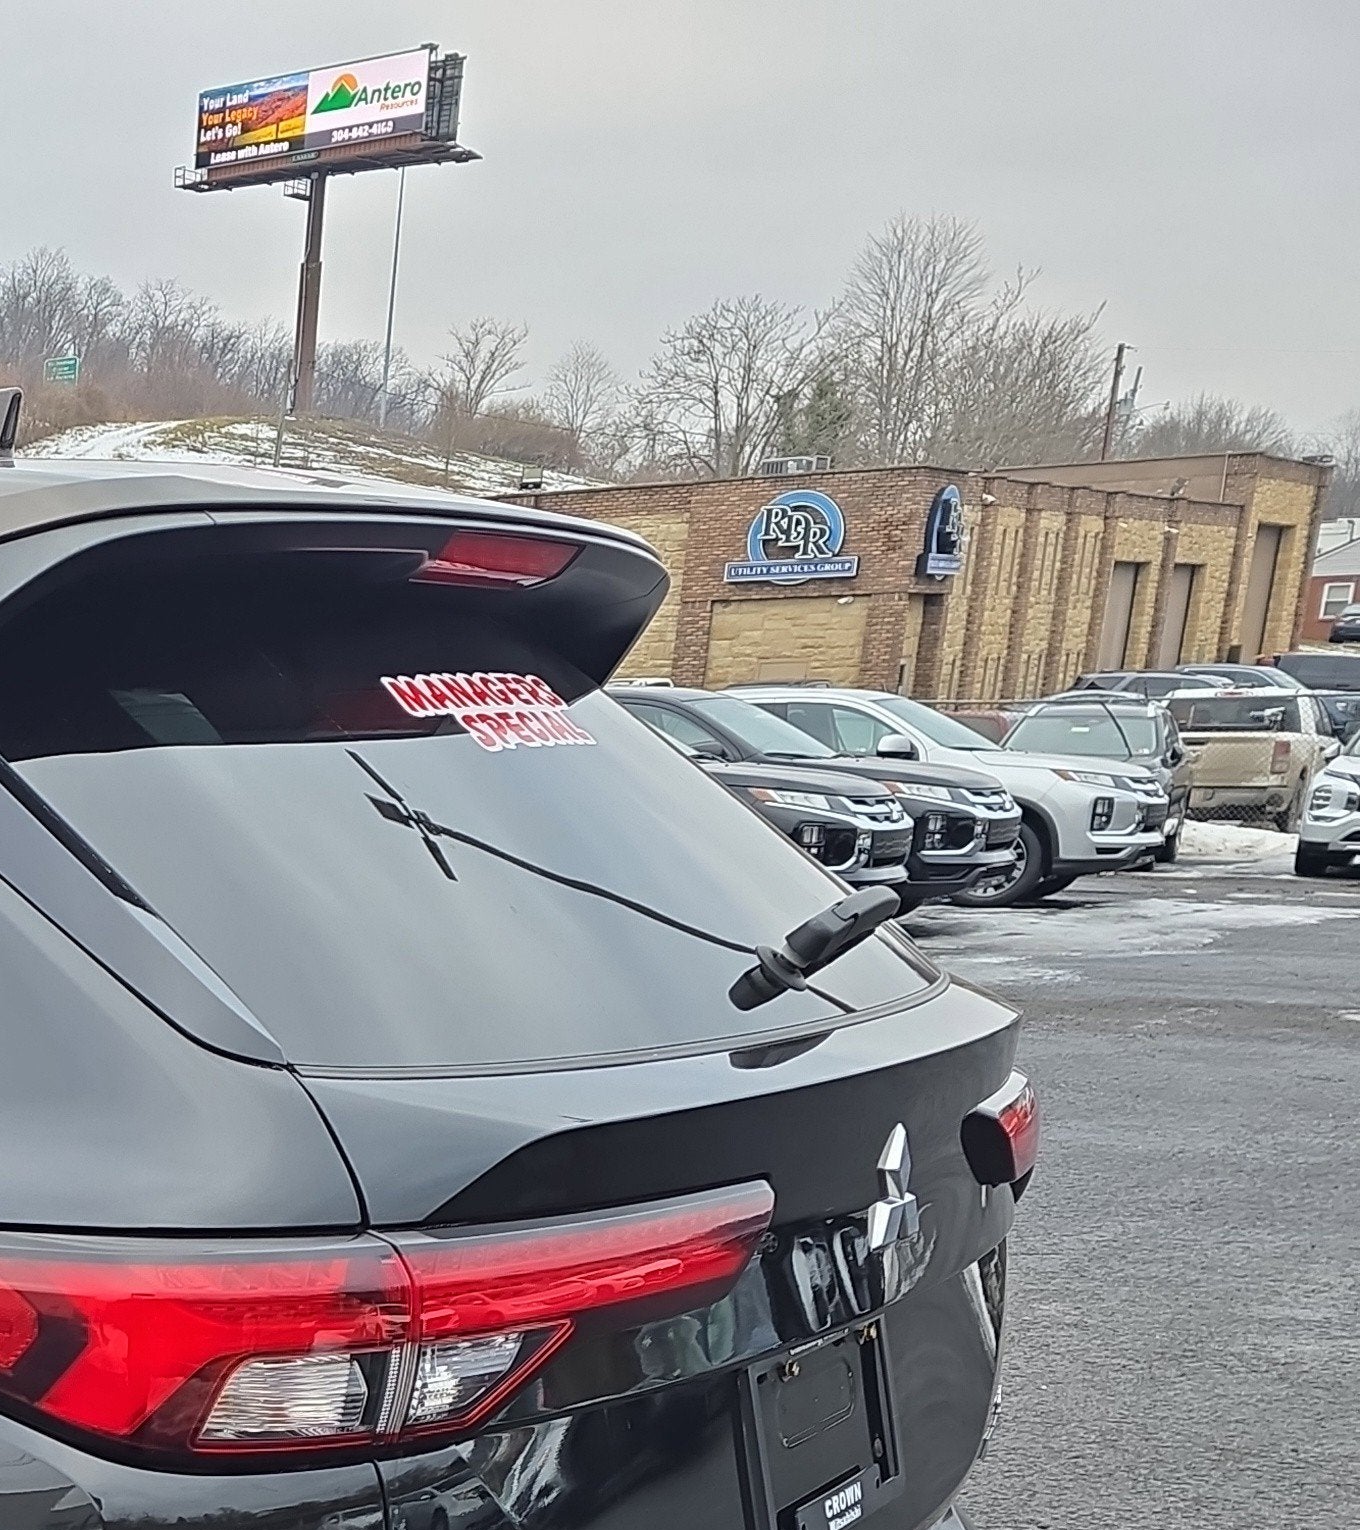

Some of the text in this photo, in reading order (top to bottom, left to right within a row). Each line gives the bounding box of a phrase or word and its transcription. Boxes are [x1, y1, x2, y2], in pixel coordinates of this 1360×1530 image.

[203, 90, 250, 111] Your Land
[354, 79, 422, 107] Antero
[379, 98, 419, 112] Resources
[202, 106, 259, 127] Your Legacy
[200, 121, 243, 143] Let's Go!
[210, 141, 290, 165] Lease with Antero
[759, 505, 833, 559] RDR
[730, 561, 852, 577] UTILITY SERVICES GROUP
[383, 673, 568, 715] MANAGERS
[459, 709, 594, 749] SPECIAL
[824, 1481, 862, 1519] CROWN
